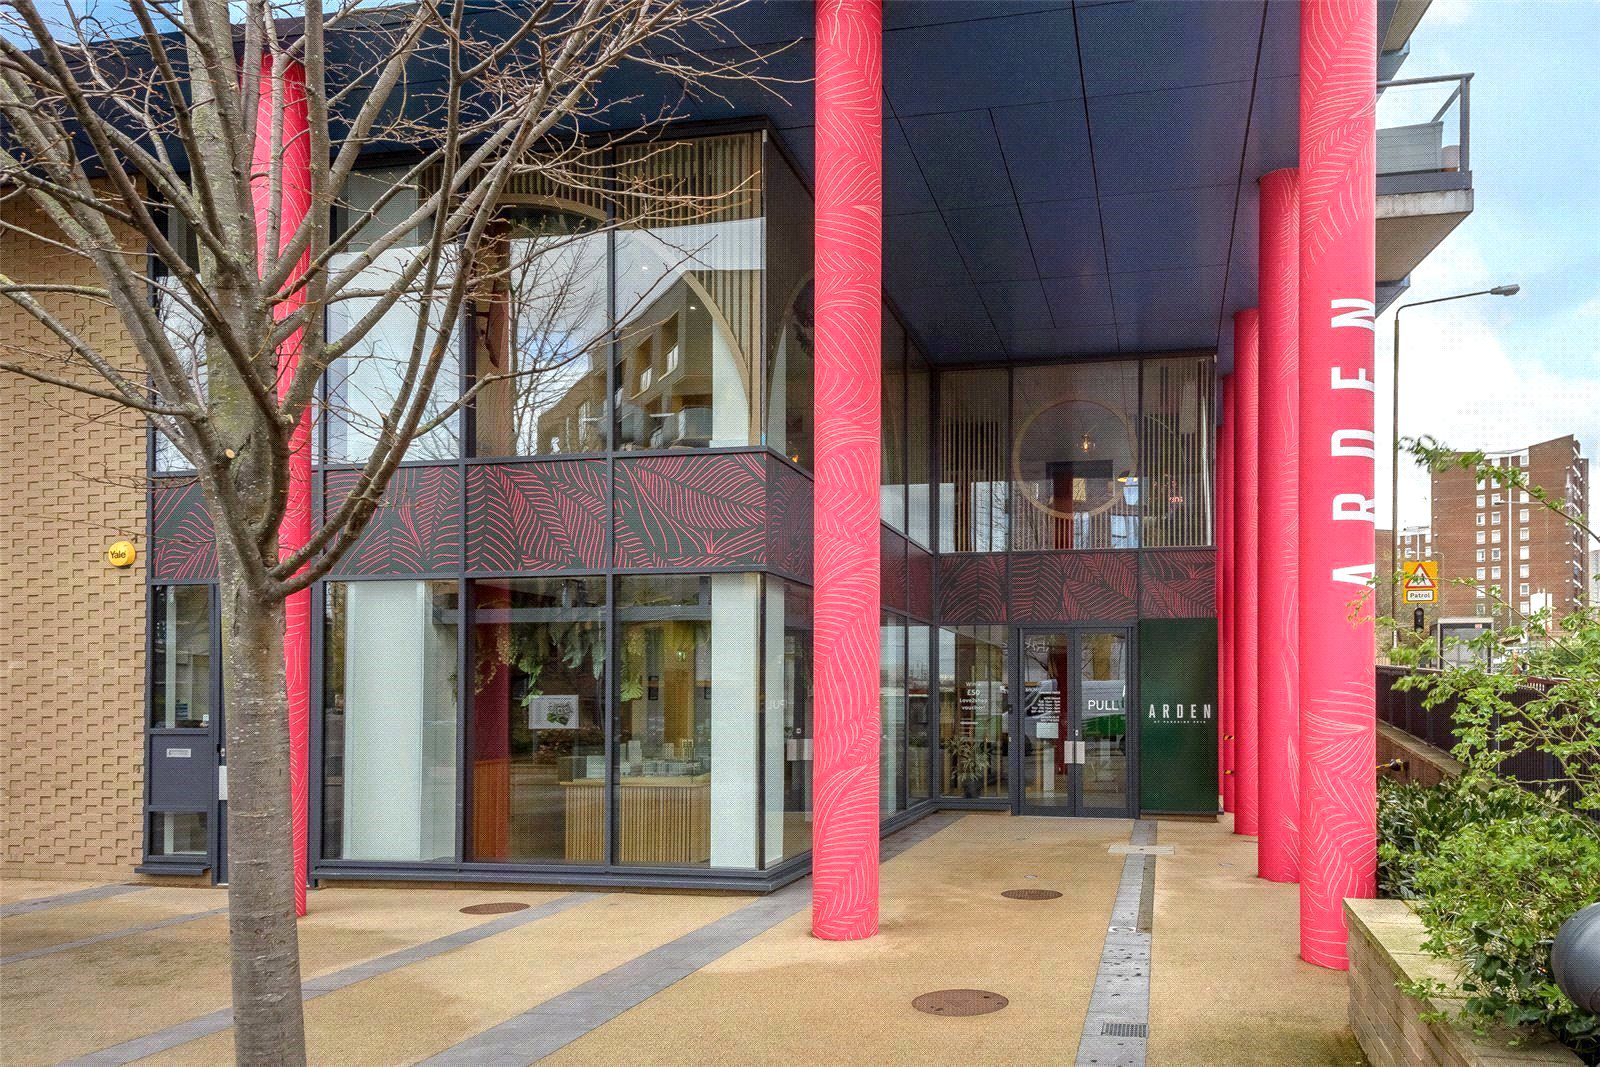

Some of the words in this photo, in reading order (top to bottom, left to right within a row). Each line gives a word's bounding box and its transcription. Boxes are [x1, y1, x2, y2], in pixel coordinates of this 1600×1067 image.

[1331, 298, 1375, 589] ARDEN
[110, 550, 126, 559] Yale
[1087, 700, 1119, 711] PULL
[1148, 703, 1212, 719] ARDEN
